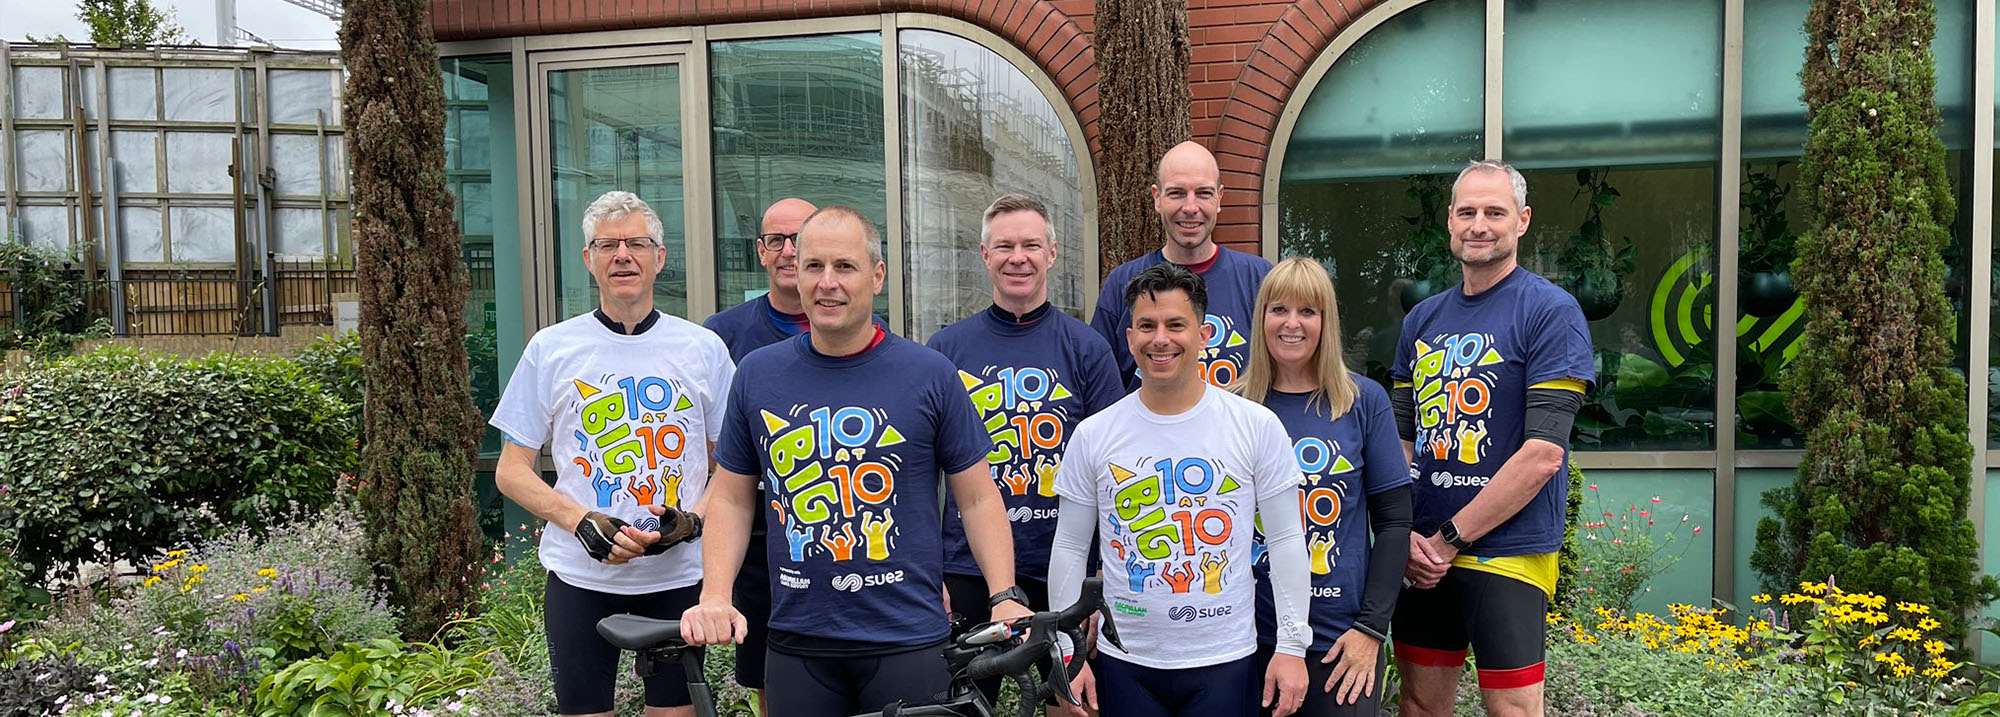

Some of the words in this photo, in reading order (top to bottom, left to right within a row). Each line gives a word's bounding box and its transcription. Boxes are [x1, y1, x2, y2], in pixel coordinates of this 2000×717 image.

[1443, 333, 1484, 376] 10
[1451, 367, 1472, 379] AT
[617, 376, 672, 420] 10
[997, 366, 1049, 410] 10
[1016, 401, 1043, 413] AT
[1413, 349, 1448, 428] BIG
[1444, 378, 1490, 424] 10
[581, 392, 644, 475] BIG
[642, 413, 667, 423] AT
[809, 406, 875, 459] 10
[1010, 412, 1063, 459] 10
[635, 424, 686, 470] 10
[834, 447, 866, 463] AT
[1293, 436, 1330, 473] 0
[769, 424, 839, 524] BIG
[828, 461, 894, 518] 10
[1154, 457, 1214, 505] 10
[1453, 475, 1490, 487] suez
[1033, 508, 1060, 519] sue
[1115, 475, 1180, 561] BIG
[1178, 495, 1208, 508] AT
[1171, 508, 1232, 556] 10
[864, 569, 904, 587] suez
[1198, 605, 1232, 619] suez
[1283, 614, 1301, 638] GORE
